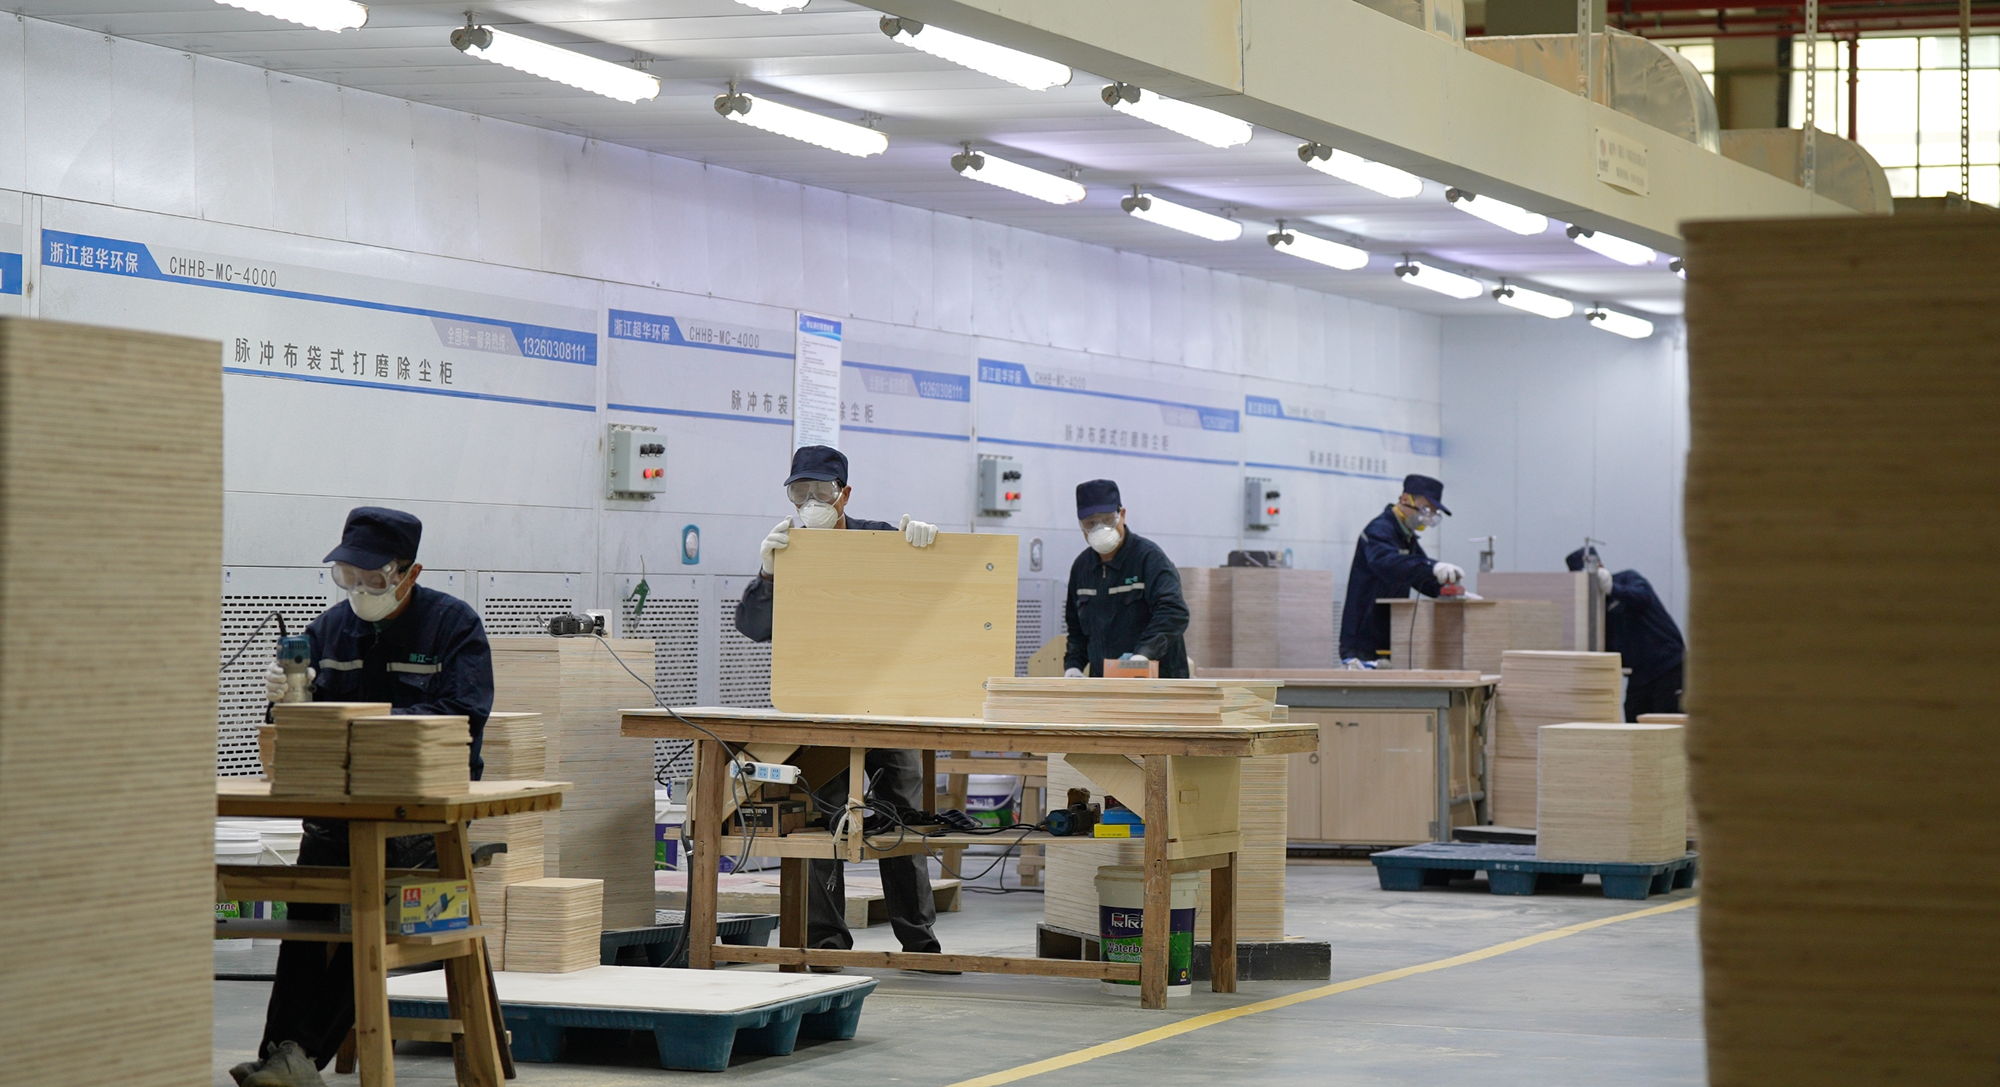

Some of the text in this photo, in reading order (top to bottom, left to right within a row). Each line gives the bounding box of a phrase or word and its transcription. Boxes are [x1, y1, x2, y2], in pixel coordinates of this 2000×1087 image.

[50, 241, 139, 274] 浙江超华环保
[169, 256, 278, 288] CHHB-MC-4000
[613, 318, 671, 342] 浙江超华环保
[689, 326, 760, 349] CHHB-MC-4000
[234, 337, 453, 385] 脉冲布袋式打磨除尘柜
[523, 337, 586, 362] 13260308111
